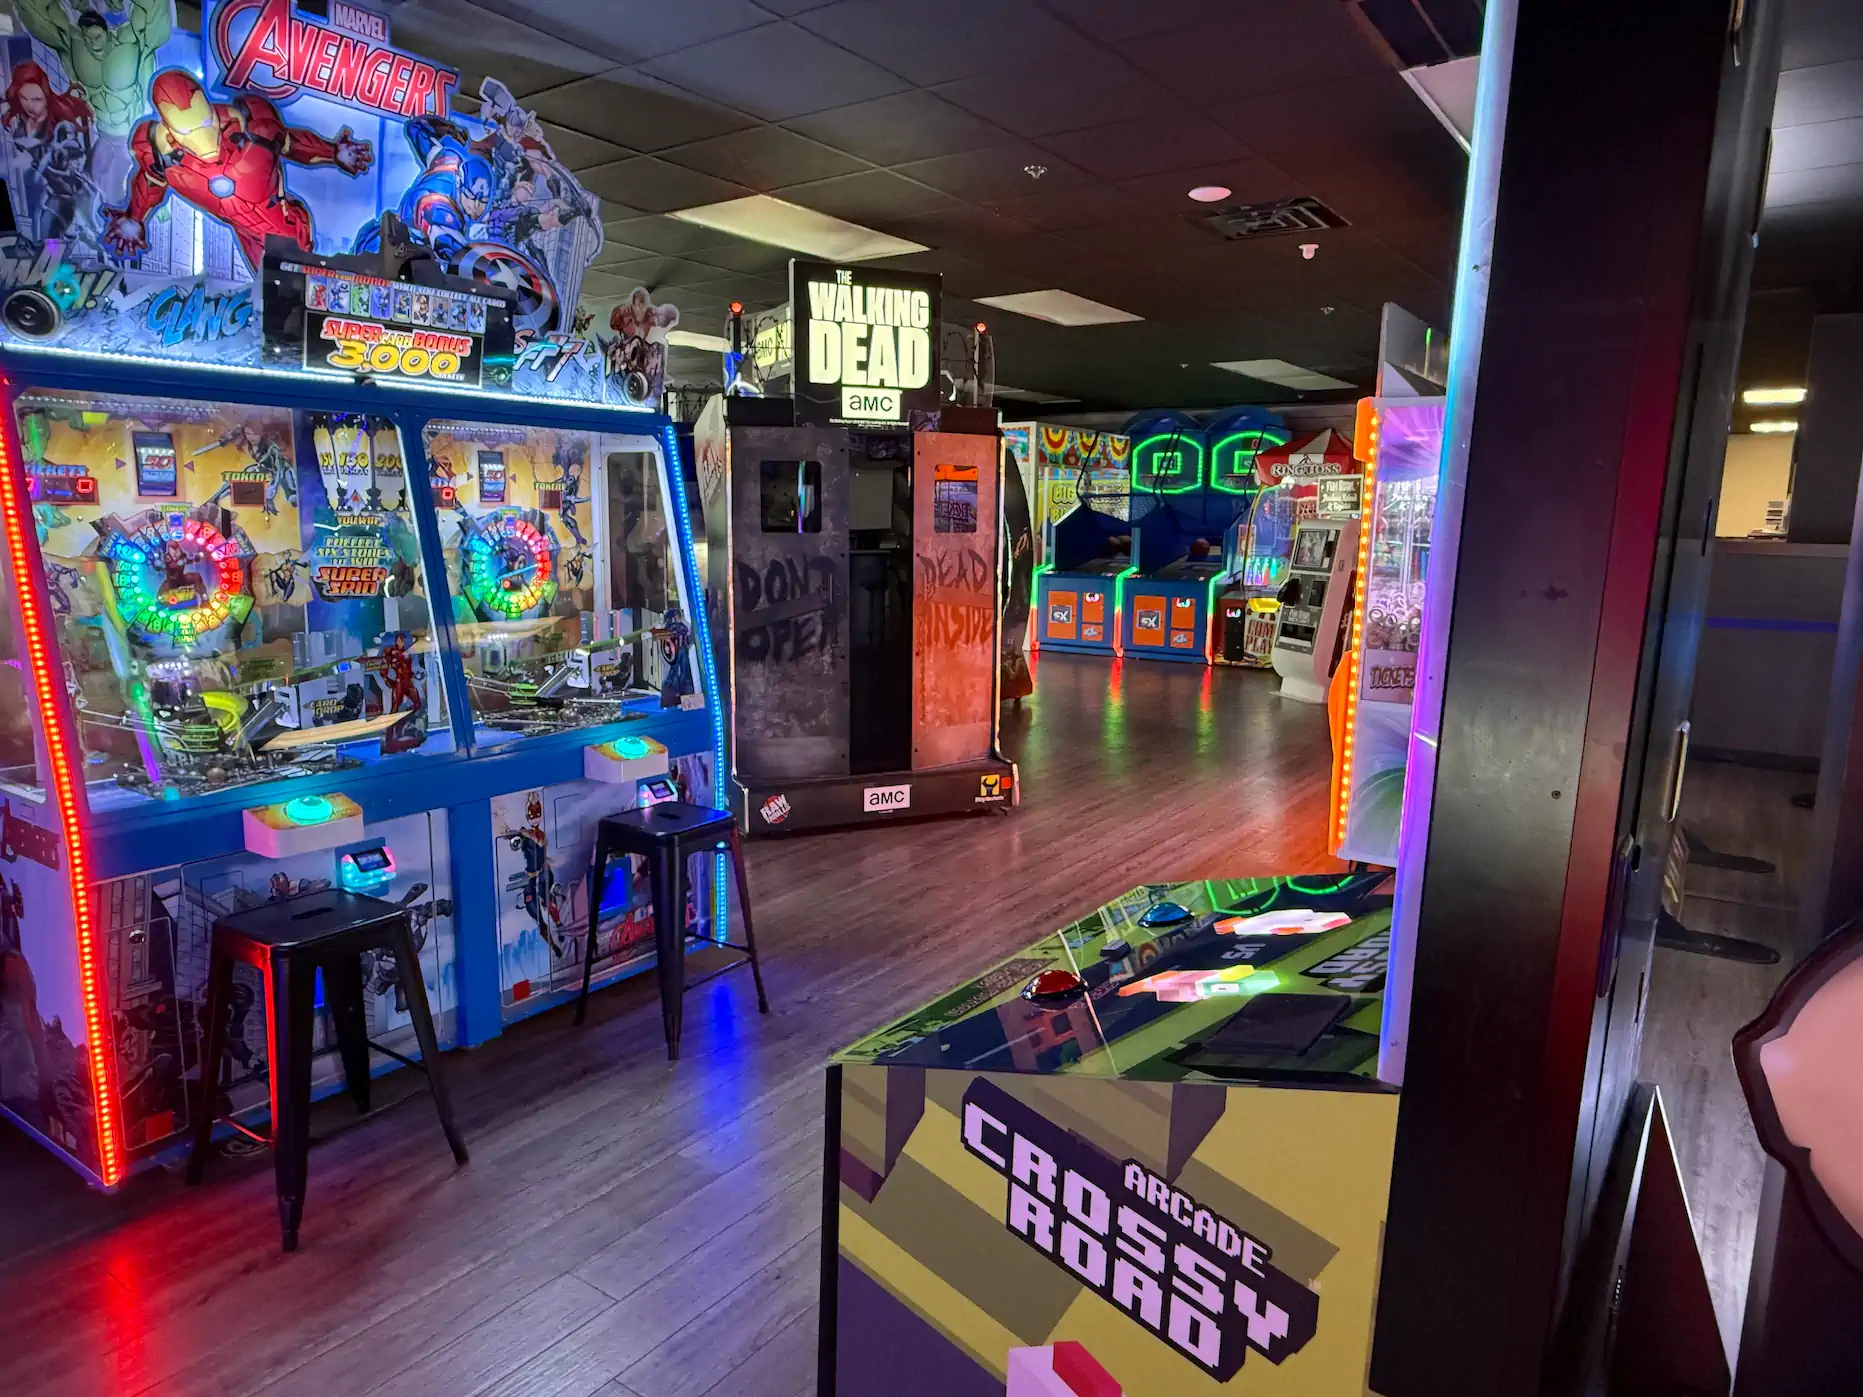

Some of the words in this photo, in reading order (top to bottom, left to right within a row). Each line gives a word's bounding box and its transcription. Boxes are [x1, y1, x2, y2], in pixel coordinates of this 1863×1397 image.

[335, 6, 386, 40] MARVEL
[225, 0, 456, 119] AVENGERS
[836, 269, 853, 286] THE
[149, 282, 253, 347] CLANG
[808, 280, 930, 329] WALKING
[324, 319, 383, 343] SUPER
[412, 332, 470, 354] BONUS
[329, 338, 458, 375] 3,000
[808, 318, 930, 390] DEAD
[1054, 485, 1076, 502] BIG
[1271, 463, 1304, 477] RING
[318, 566, 388, 582] SUPER
[327, 581, 377, 595] SPIN
[919, 548, 988, 595] DEAD
[925, 602, 994, 650] INSIDE
[963, 1101, 1290, 1351] CROSSY
[1124, 1161, 1270, 1279] ARCADE
[1010, 1181, 1222, 1369] ROAD
